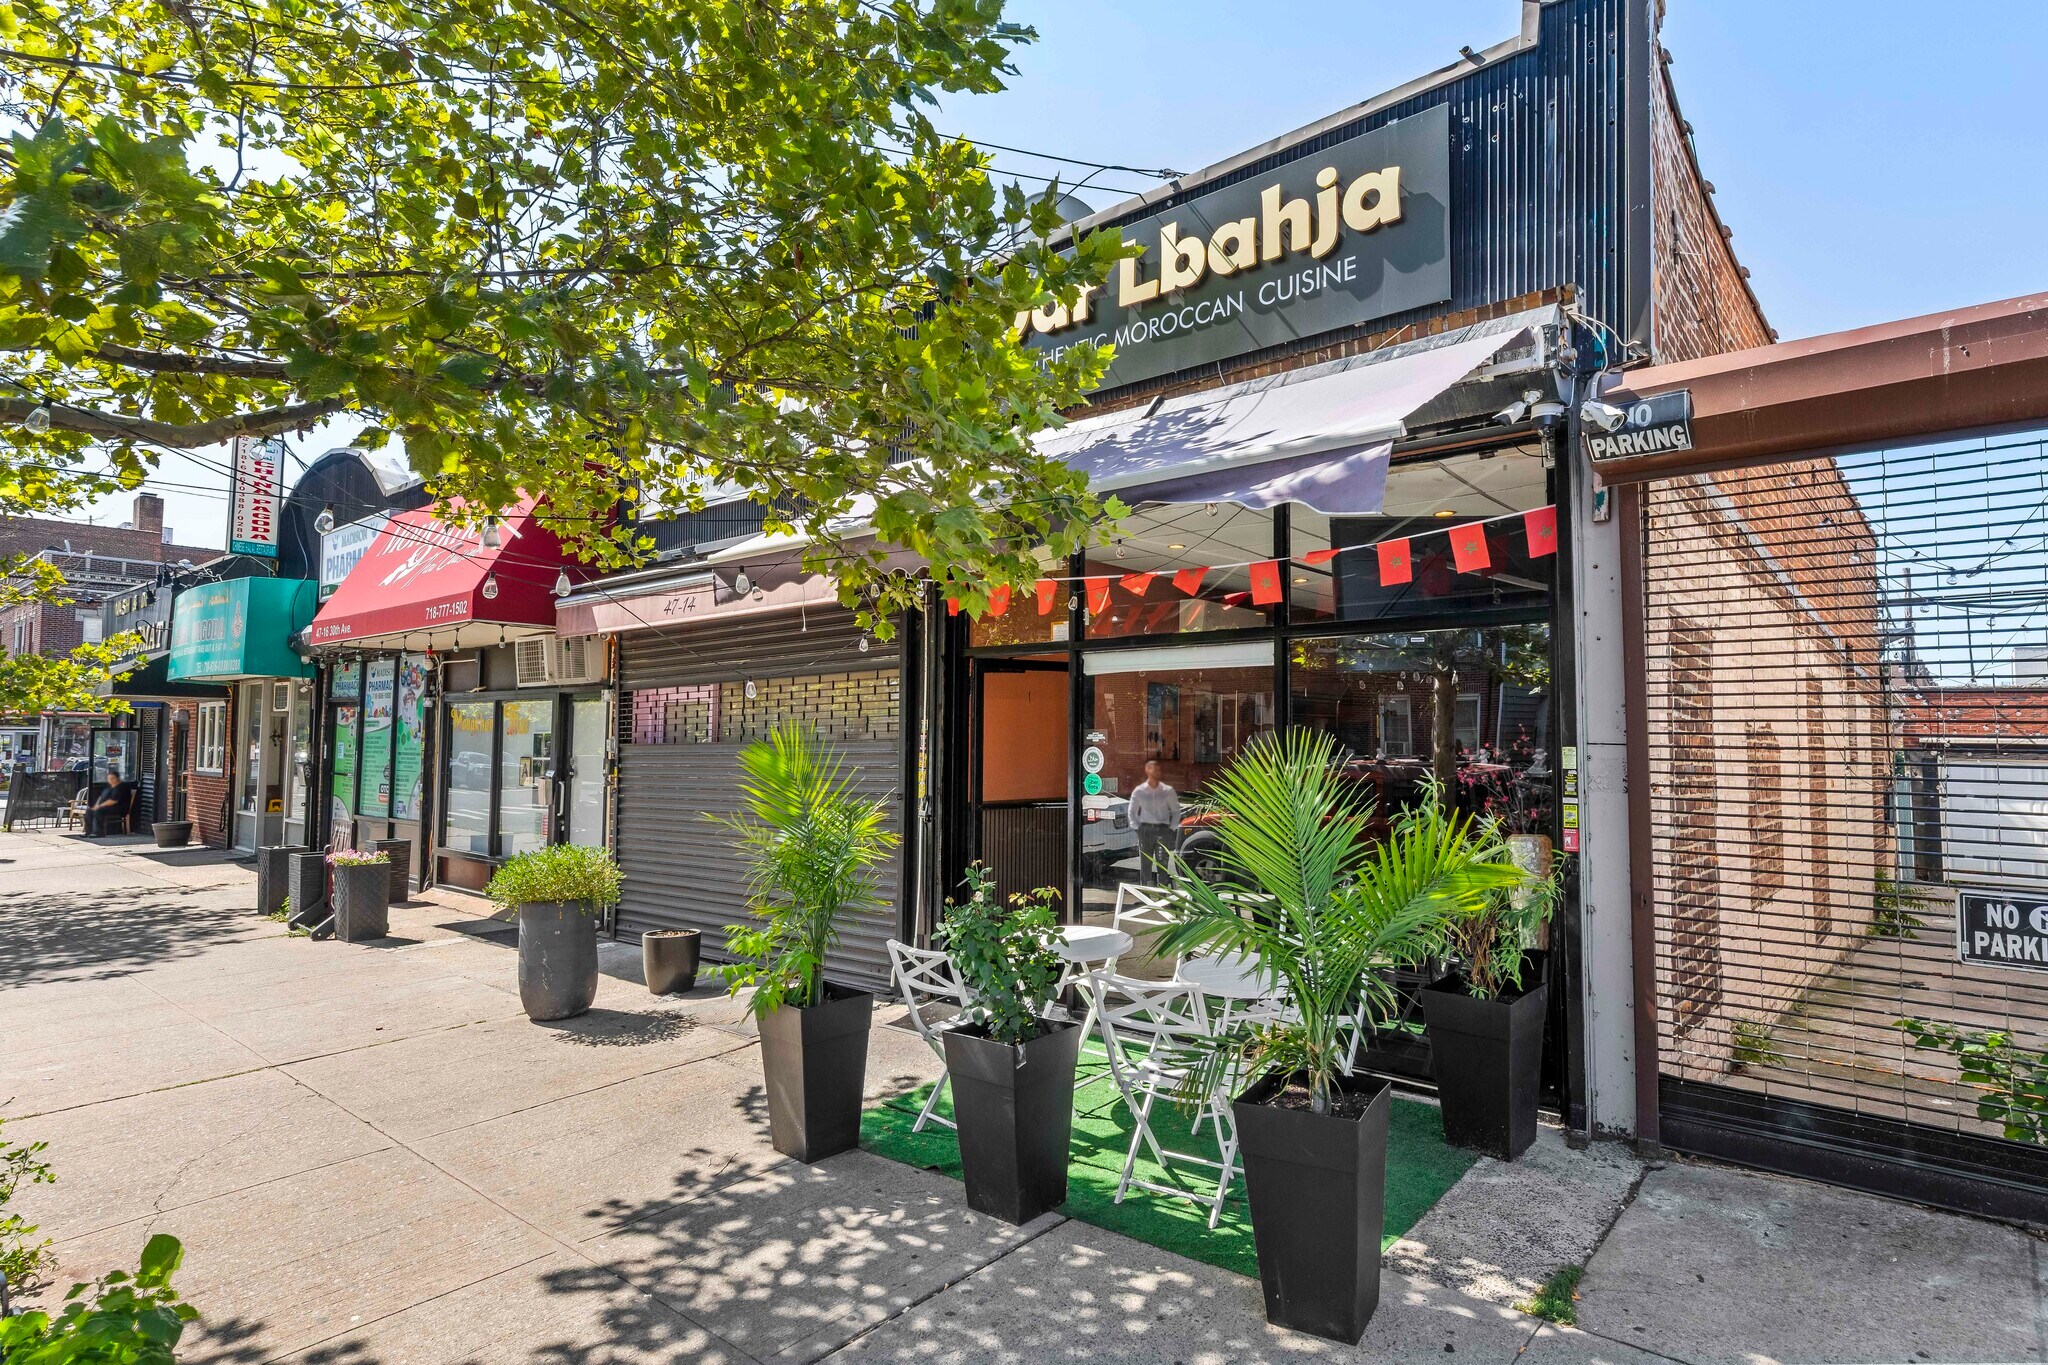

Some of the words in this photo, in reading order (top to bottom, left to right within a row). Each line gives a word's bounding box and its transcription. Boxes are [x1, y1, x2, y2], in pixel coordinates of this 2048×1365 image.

[1002, 279, 1098, 341] ar
[1117, 165, 1402, 309] Lbahja
[1113, 290, 1243, 348] MOROCCAN
[1258, 255, 1357, 306] CUISINE
[1591, 424, 1687, 459] PARKING
[252, 460, 275, 497] CHINA
[249, 498, 272, 542] PAGODA
[341, 528, 368, 548] MADISON
[325, 546, 368, 582] PHARM
[425, 600, 468, 620] 718-777-1502
[663, 596, 697, 615] 47-14
[315, 626, 330, 639] 47-16
[330, 624, 341, 636] 30th
[341, 623, 352, 635] Ave.
[368, 680, 393, 692] PHARMAC
[1986, 903, 2020, 930] NO
